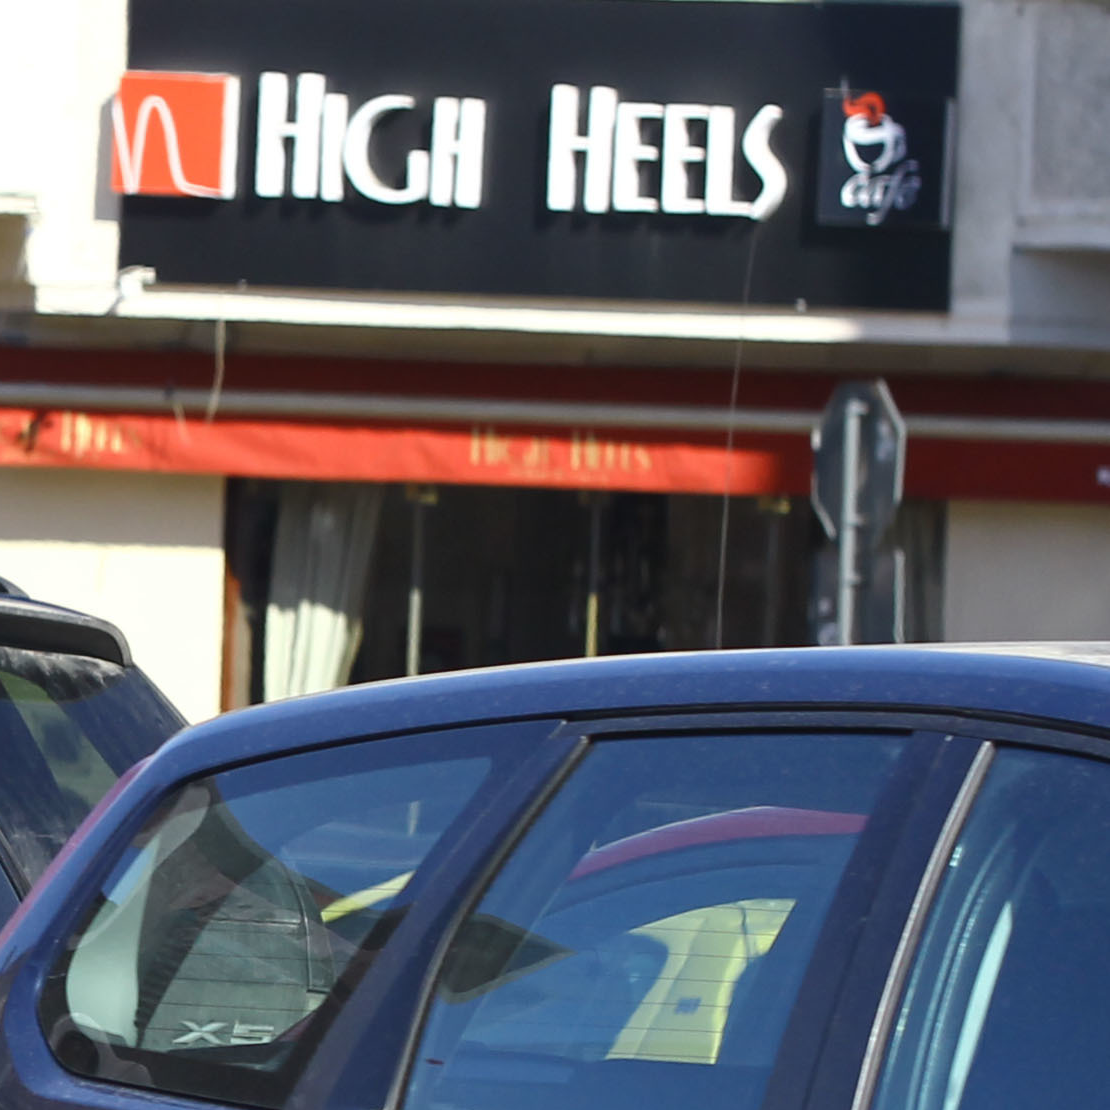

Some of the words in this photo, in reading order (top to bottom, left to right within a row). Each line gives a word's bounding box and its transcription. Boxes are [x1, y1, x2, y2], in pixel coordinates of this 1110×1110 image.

[255, 71, 487, 209] HIGH
[546, 84, 788, 221] HEELS
[171, 1019, 276, 1047] X5
